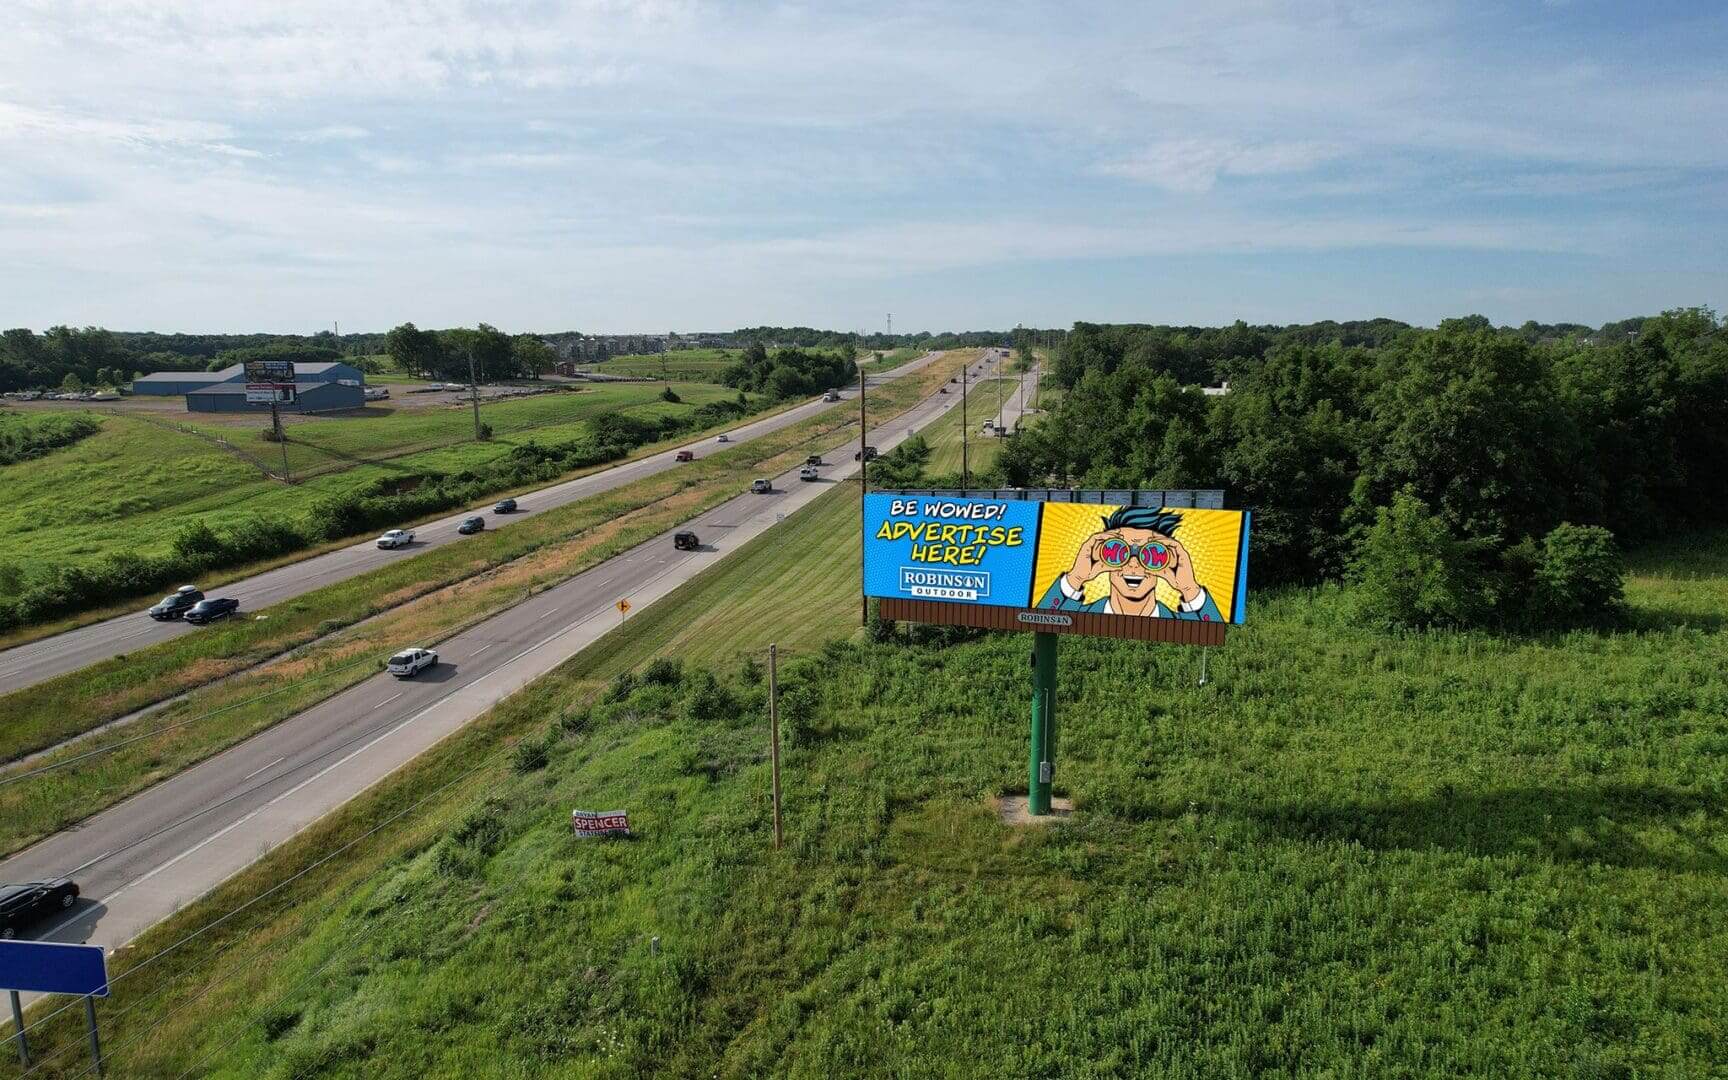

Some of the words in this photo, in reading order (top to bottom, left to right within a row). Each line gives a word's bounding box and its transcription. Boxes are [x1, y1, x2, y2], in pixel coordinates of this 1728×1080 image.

[890, 499, 917, 516] BE
[925, 501, 1007, 521] WOWED!
[876, 520, 1023, 546] ADVERTISE
[911, 543, 986, 566] HERE!
[904, 571, 985, 589] ROBINSON
[916, 588, 972, 598] OUTDOOR
[575, 817, 627, 829] SPENCER
